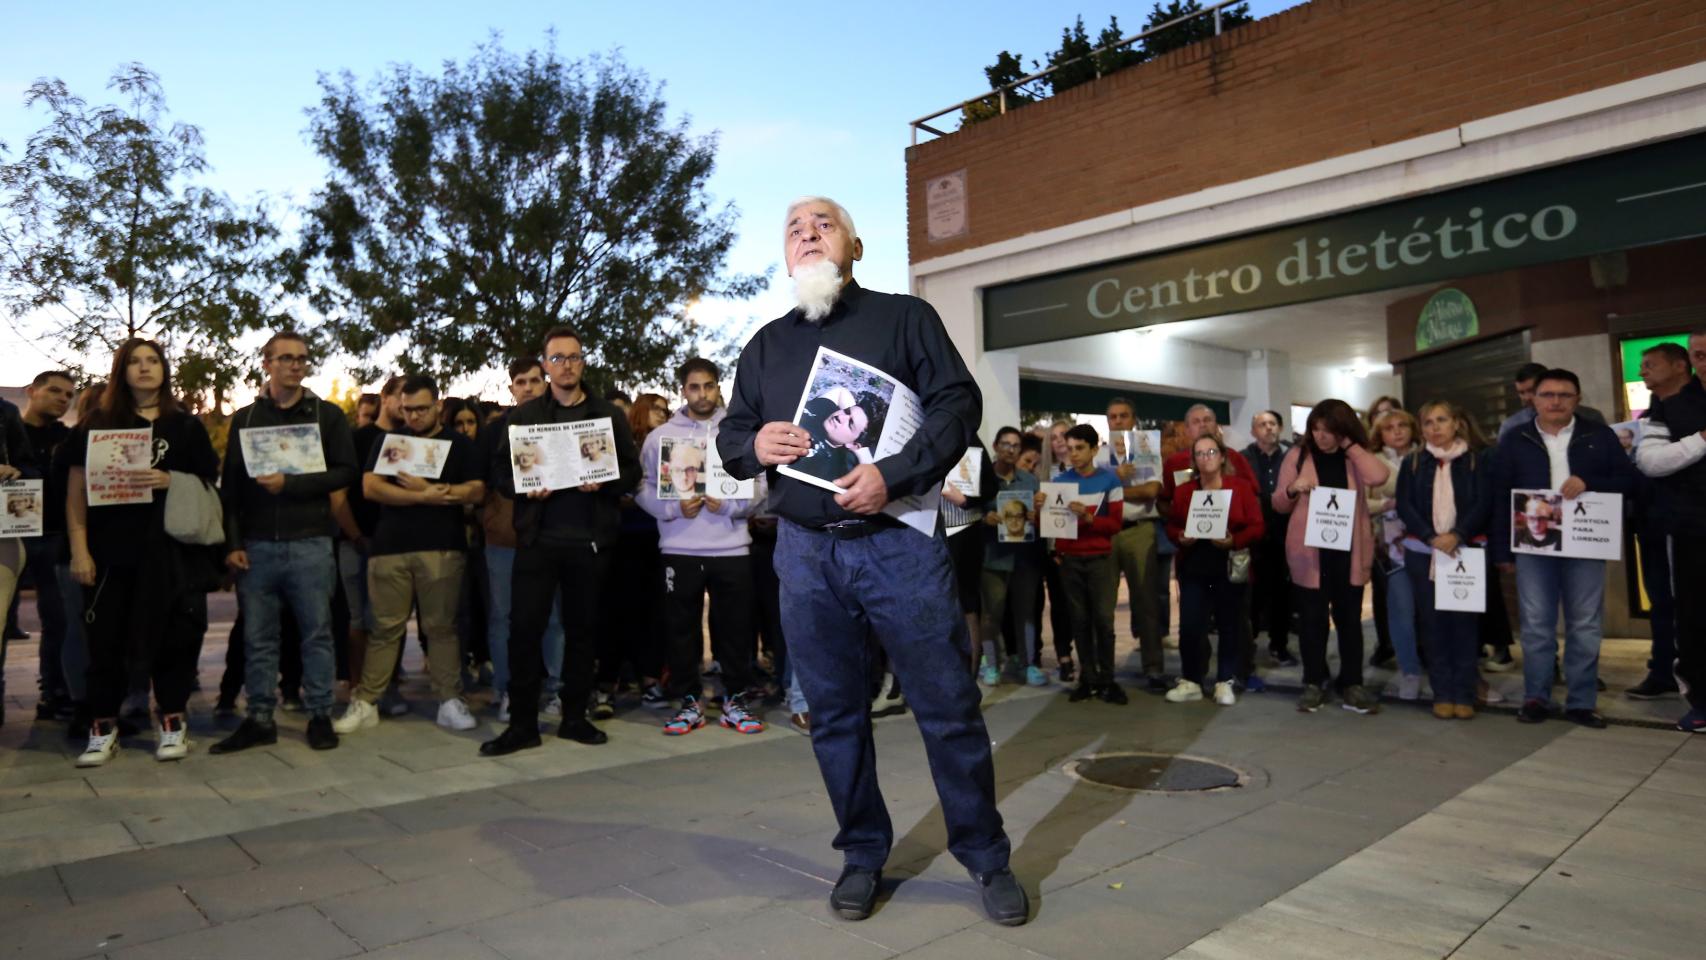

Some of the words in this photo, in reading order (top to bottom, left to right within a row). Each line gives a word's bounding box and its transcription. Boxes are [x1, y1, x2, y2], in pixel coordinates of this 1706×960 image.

[1087, 264, 1261, 319] Centro
[1276, 205, 1577, 286] dietético
[571, 422, 595, 430] LORENZO
[92, 432, 149, 443] Lorenzo
